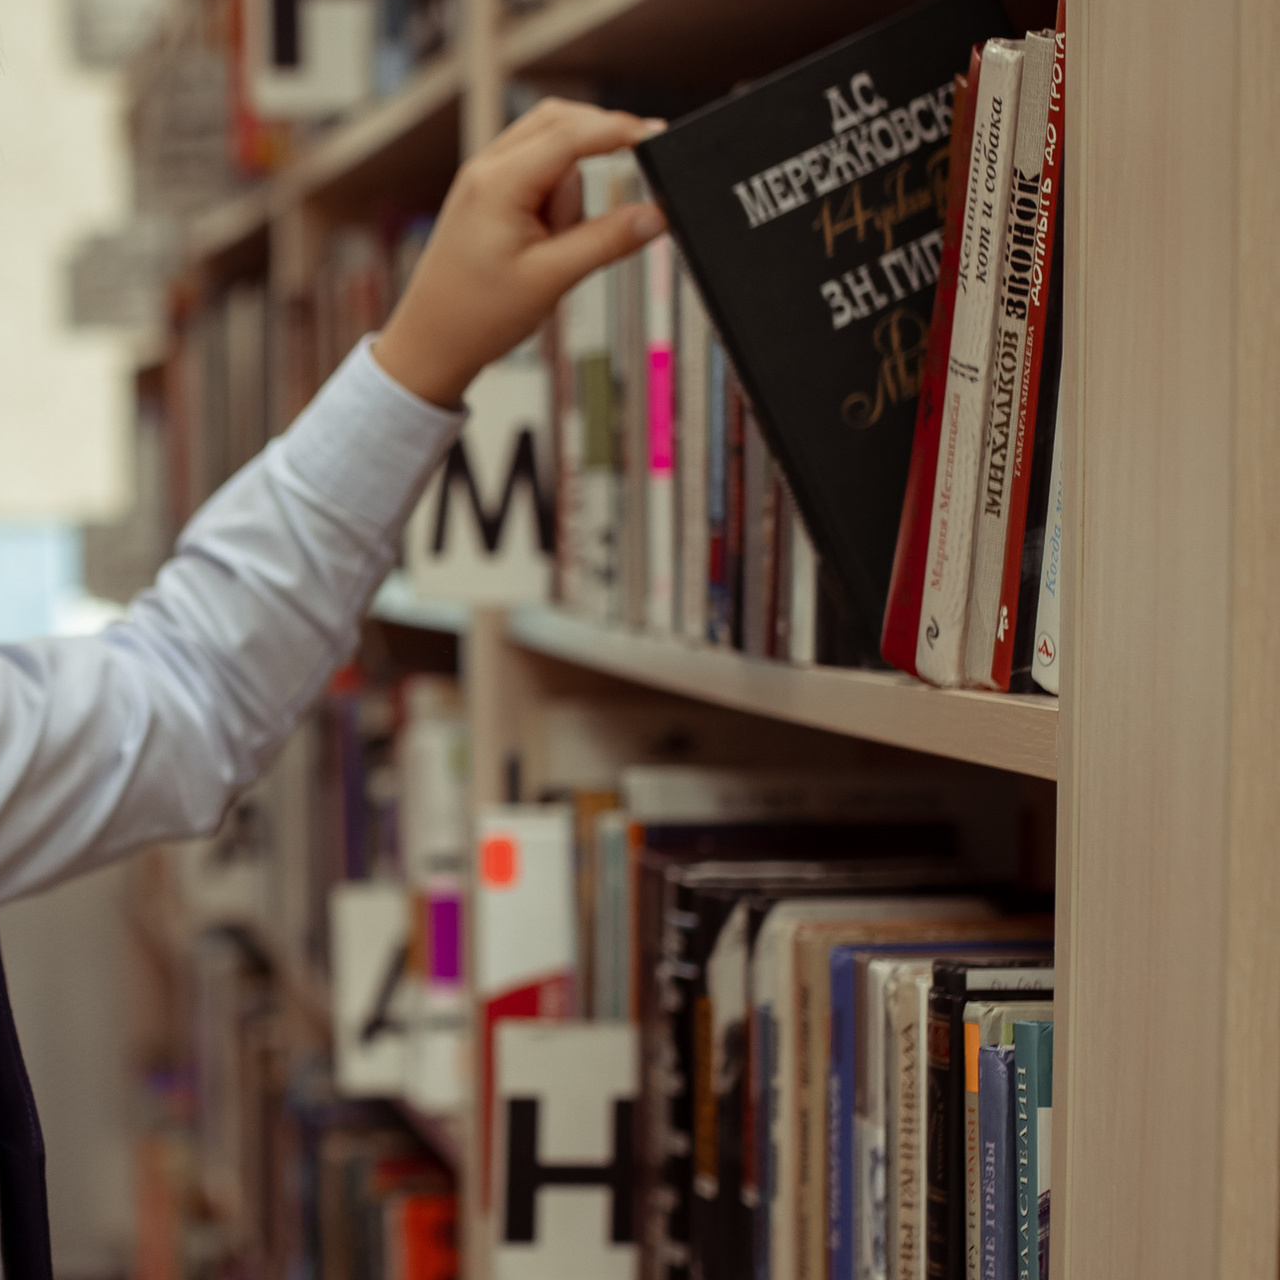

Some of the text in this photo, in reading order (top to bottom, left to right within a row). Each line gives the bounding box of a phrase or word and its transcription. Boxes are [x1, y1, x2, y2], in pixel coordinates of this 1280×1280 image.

[973, 95, 1004, 284] кот и собака
[1004, 166, 1040, 320] ЗВОНОК
[1030, 31, 1066, 307] ДОПЛЫТЬ ДО ГРОТА
[984, 329, 1019, 519] МИХАЛКОВ
[1013, 325, 1036, 478] ТАМАРА МИХЕЕВА
[432, 429, 557, 554] М
[928, 517, 950, 592] Мария
[1045, 523, 1063, 598] Когда
[505, 1096, 636, 1244] Н
[981, 1140, 997, 1230] ГРЁЗЫ
